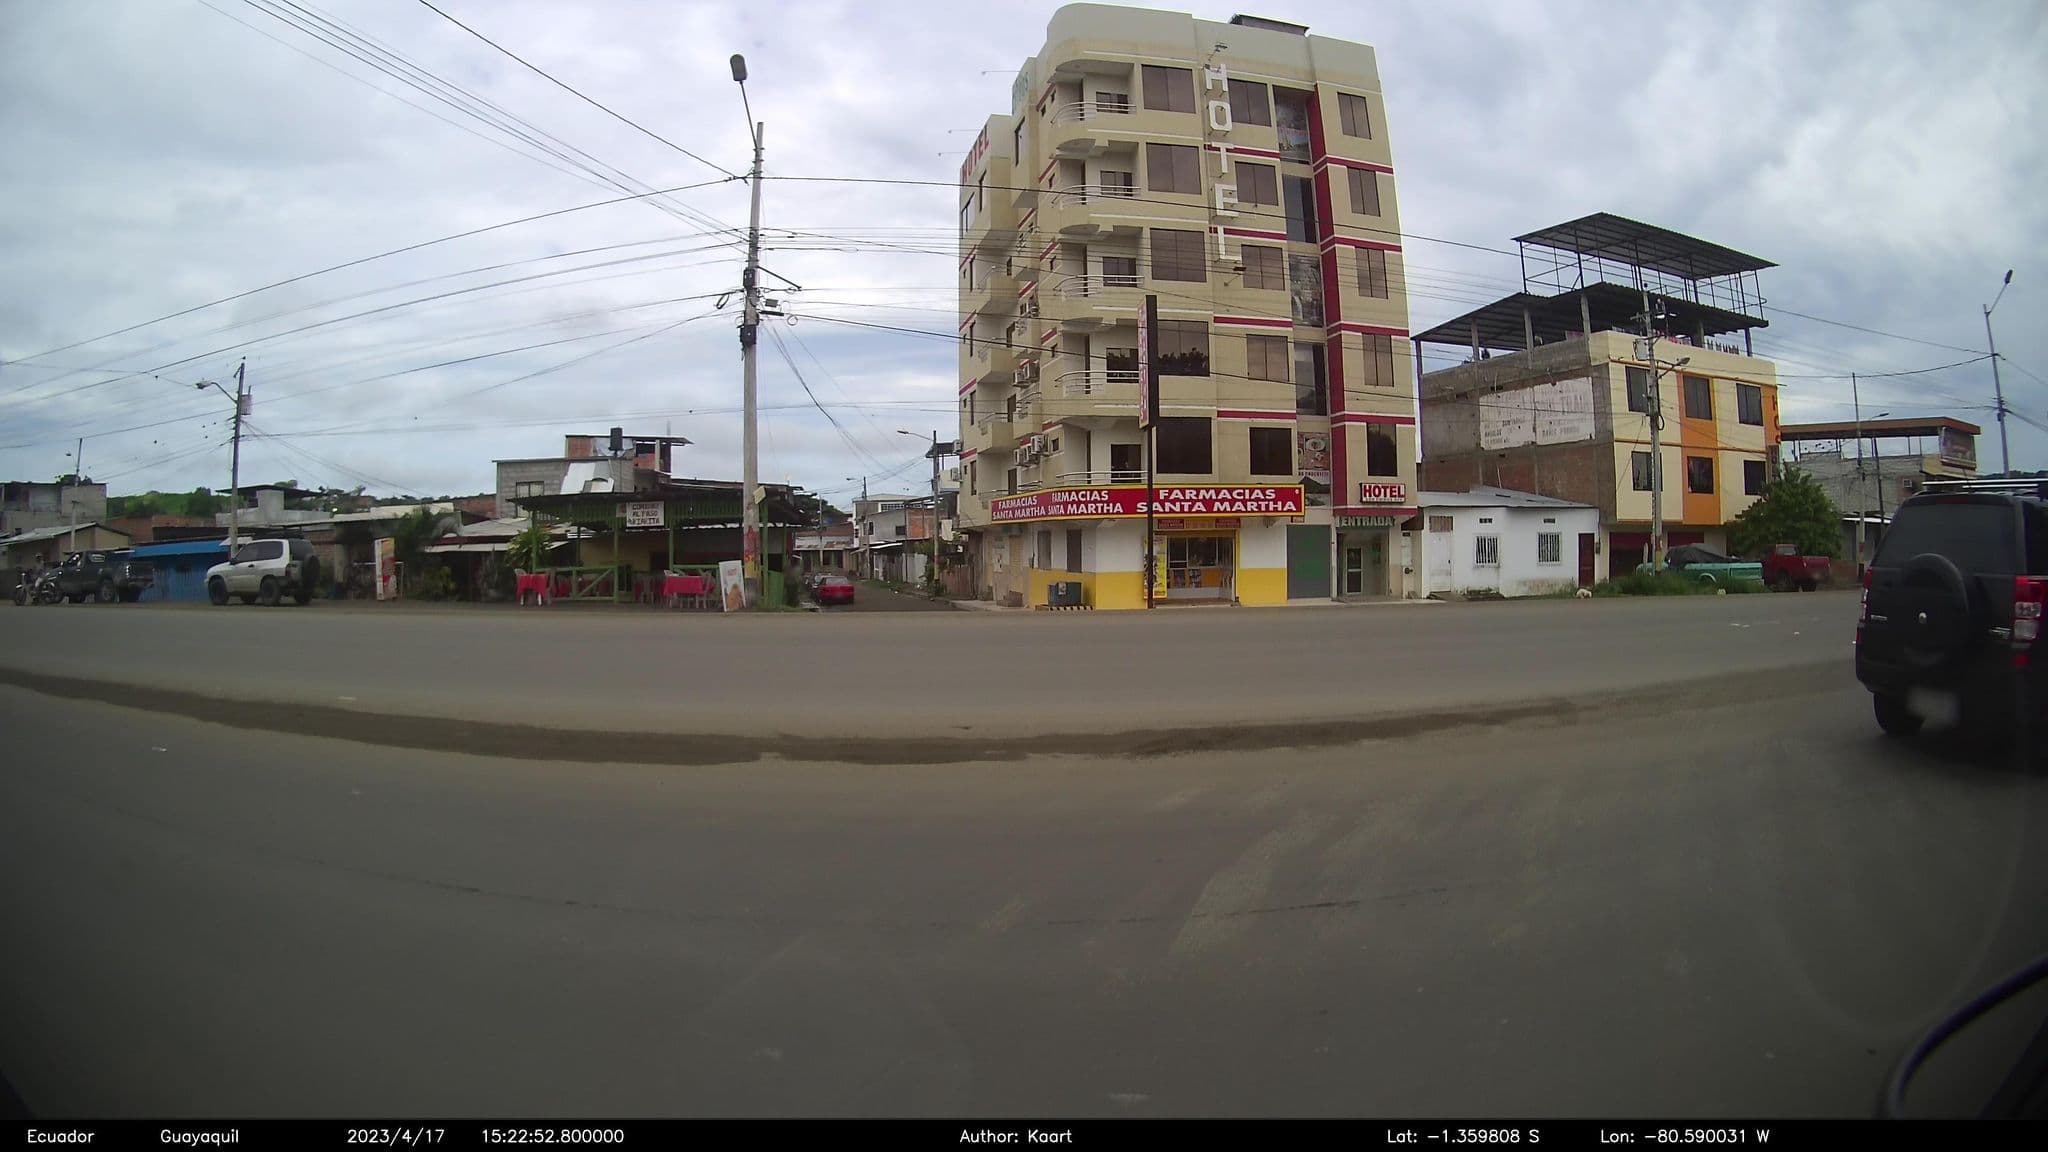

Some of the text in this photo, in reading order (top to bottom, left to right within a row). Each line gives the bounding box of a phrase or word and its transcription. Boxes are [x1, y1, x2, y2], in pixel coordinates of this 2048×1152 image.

[961, 123, 990, 184] HOTEL
[1204, 63, 1243, 262] HOTEL
[1052, 490, 1109, 502] FARMACIAS
[1159, 489, 1276, 500] FARMACIAS
[1363, 484, 1406, 498] HOTEL
[998, 495, 1038, 509] FARMACIAS
[1048, 502, 1124, 515] SANTA MARTHA
[1136, 501, 1297, 513] SANTA MARTHA
[992, 506, 1046, 520] SANTA MARTHA
[1341, 515, 1393, 527] ENTRADA
